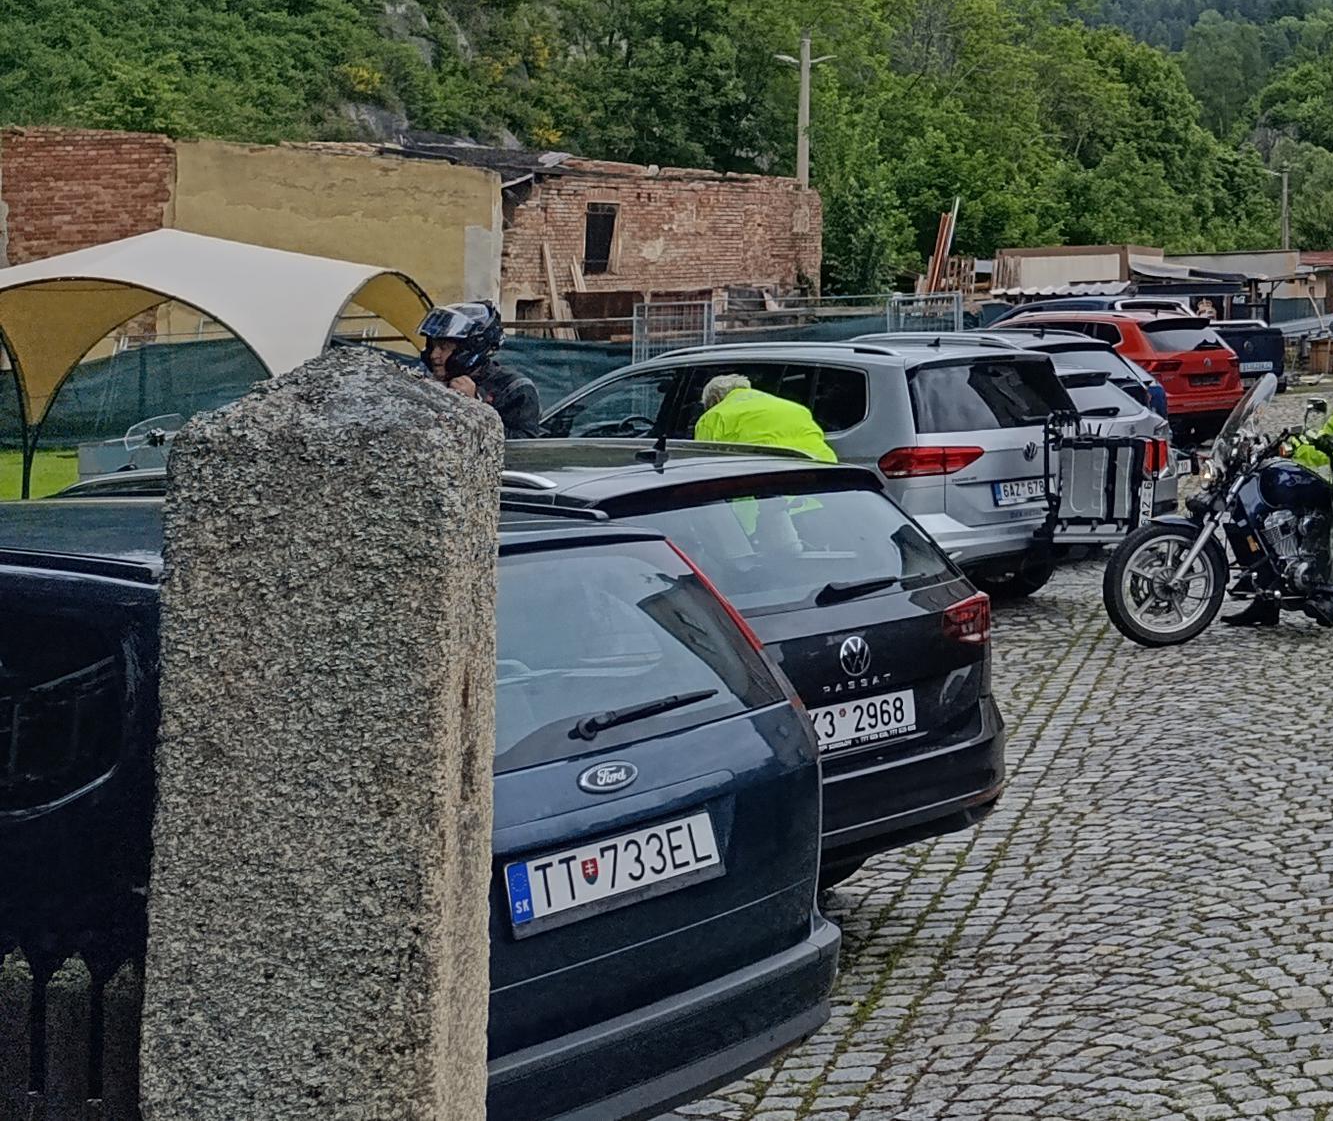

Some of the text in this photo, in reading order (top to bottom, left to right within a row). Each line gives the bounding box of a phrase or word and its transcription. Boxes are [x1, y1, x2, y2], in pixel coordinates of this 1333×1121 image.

[1027, 480, 1045, 494] 678
[852, 696, 905, 733] 2968
[597, 766, 627, 785] Ford
[534, 822, 713, 908] TT 733EL
[515, 898, 530, 914] SK
